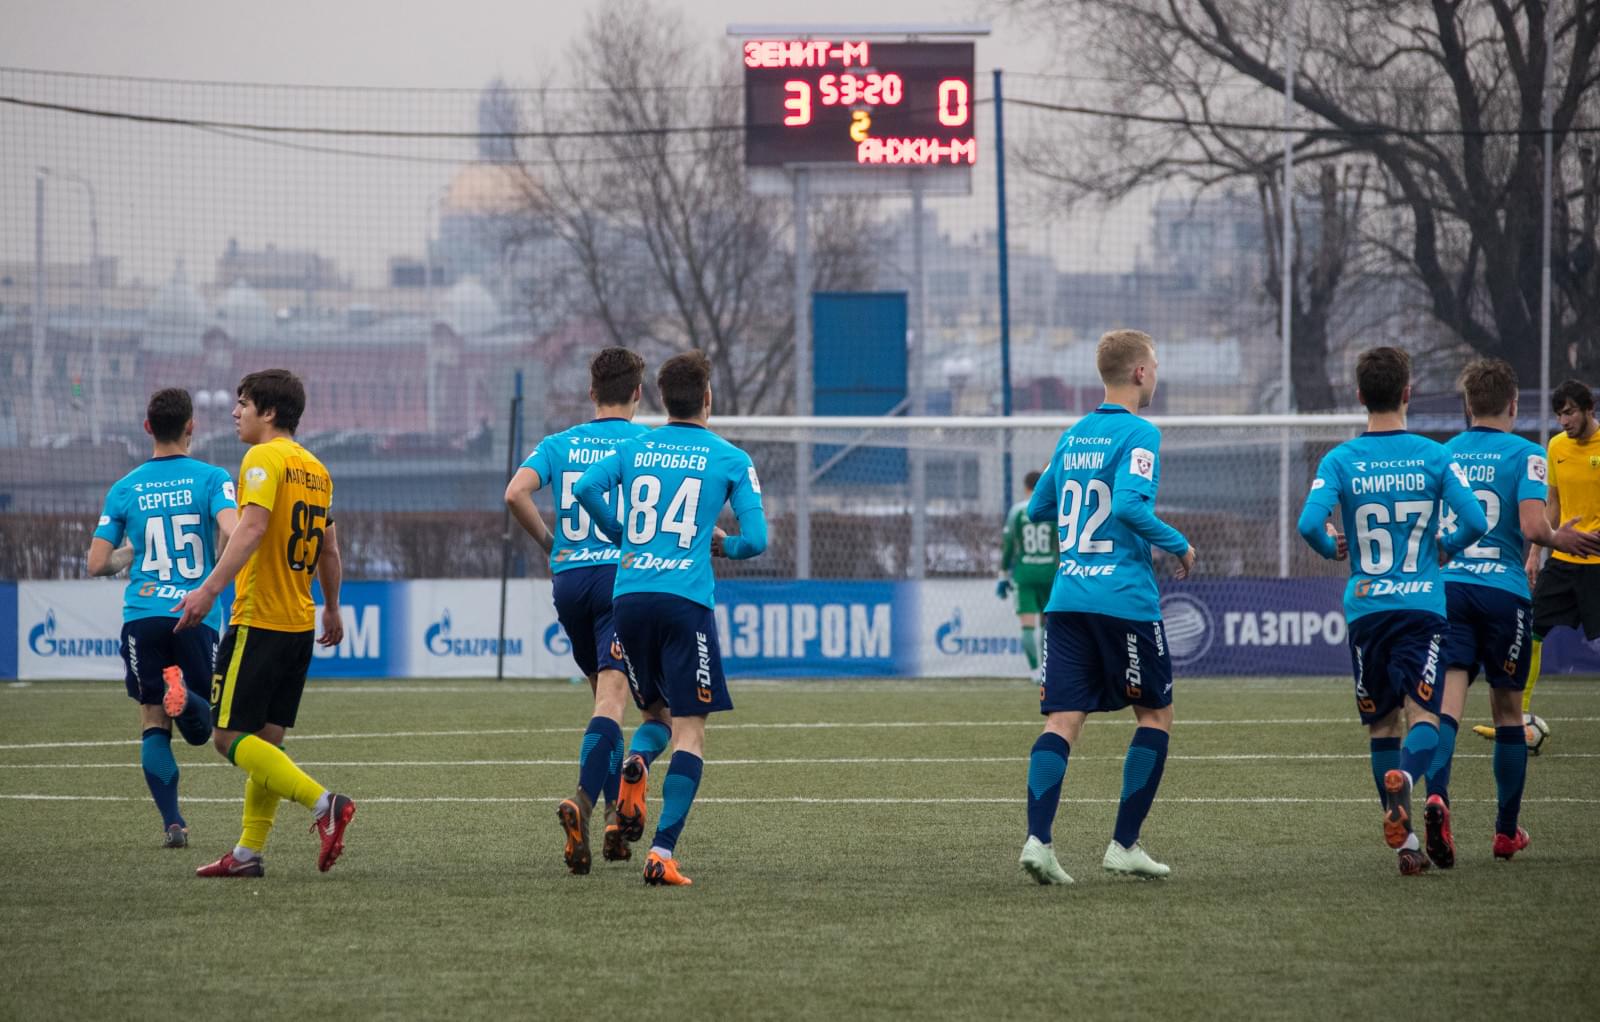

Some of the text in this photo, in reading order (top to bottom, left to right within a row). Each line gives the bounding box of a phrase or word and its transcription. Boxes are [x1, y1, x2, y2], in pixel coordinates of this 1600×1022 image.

[745, 41, 868, 67] ЗЕНИТ-М
[784, 80, 811, 126] 3
[818, 73, 902, 105] 53:20
[938, 79, 968, 126] 0
[850, 110, 871, 142] 2
[658, 443, 710, 453] РОССИЯ
[1076, 437, 1112, 445] РОССИЯ
[634, 452, 707, 471] ВОРОБЬЕВ
[1064, 452, 1104, 470] ШАМКИН
[1371, 459, 1425, 469] РОССИЯ
[146, 478, 194, 488] РОССИЯ
[1352, 474, 1426, 495] СМИРНОВ
[138, 490, 192, 511] СЕРГЕЕВ
[627, 475, 701, 549] 84
[1058, 479, 1113, 553] 92
[141, 514, 204, 581] 45
[288, 500, 326, 574] 85
[1023, 523, 1051, 554] 86
[1355, 501, 1434, 575] 67
[714, 604, 891, 658] АЗПРОМ
[1225, 612, 1347, 645] ГАЗПРО
[454, 639, 522, 655] GAZPRM
